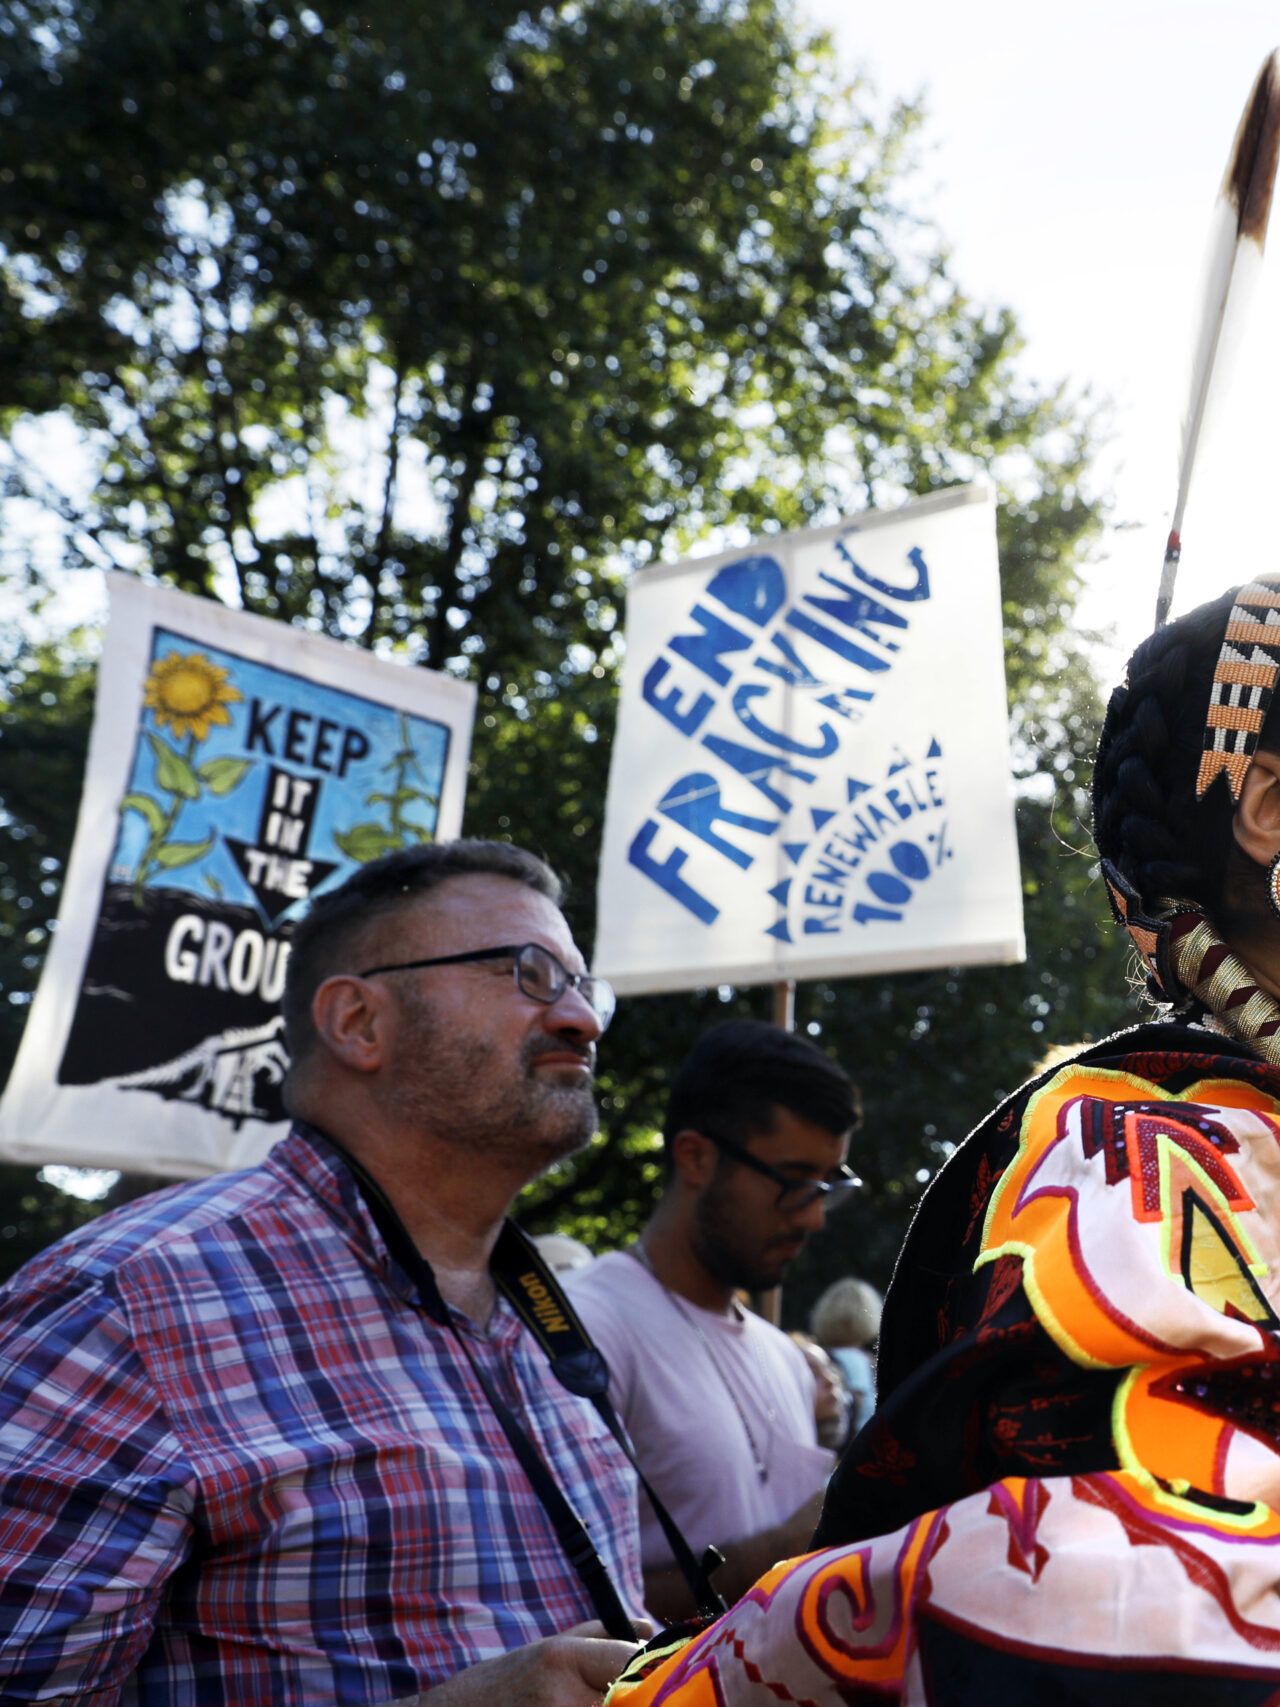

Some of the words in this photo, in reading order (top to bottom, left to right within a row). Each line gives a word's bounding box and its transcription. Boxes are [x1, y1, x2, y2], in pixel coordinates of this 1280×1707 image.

[642, 555, 787, 737] END
[245, 696, 370, 779] KEEP
[265, 813, 303, 855] IN
[273, 775, 313, 815] IT
[245, 852, 312, 899] THE
[803, 770, 943, 935] RENEWABLE
[853, 820, 953, 928] 100%
[166, 915, 292, 1002] GROU
[519, 1272, 571, 1333] Nikon
